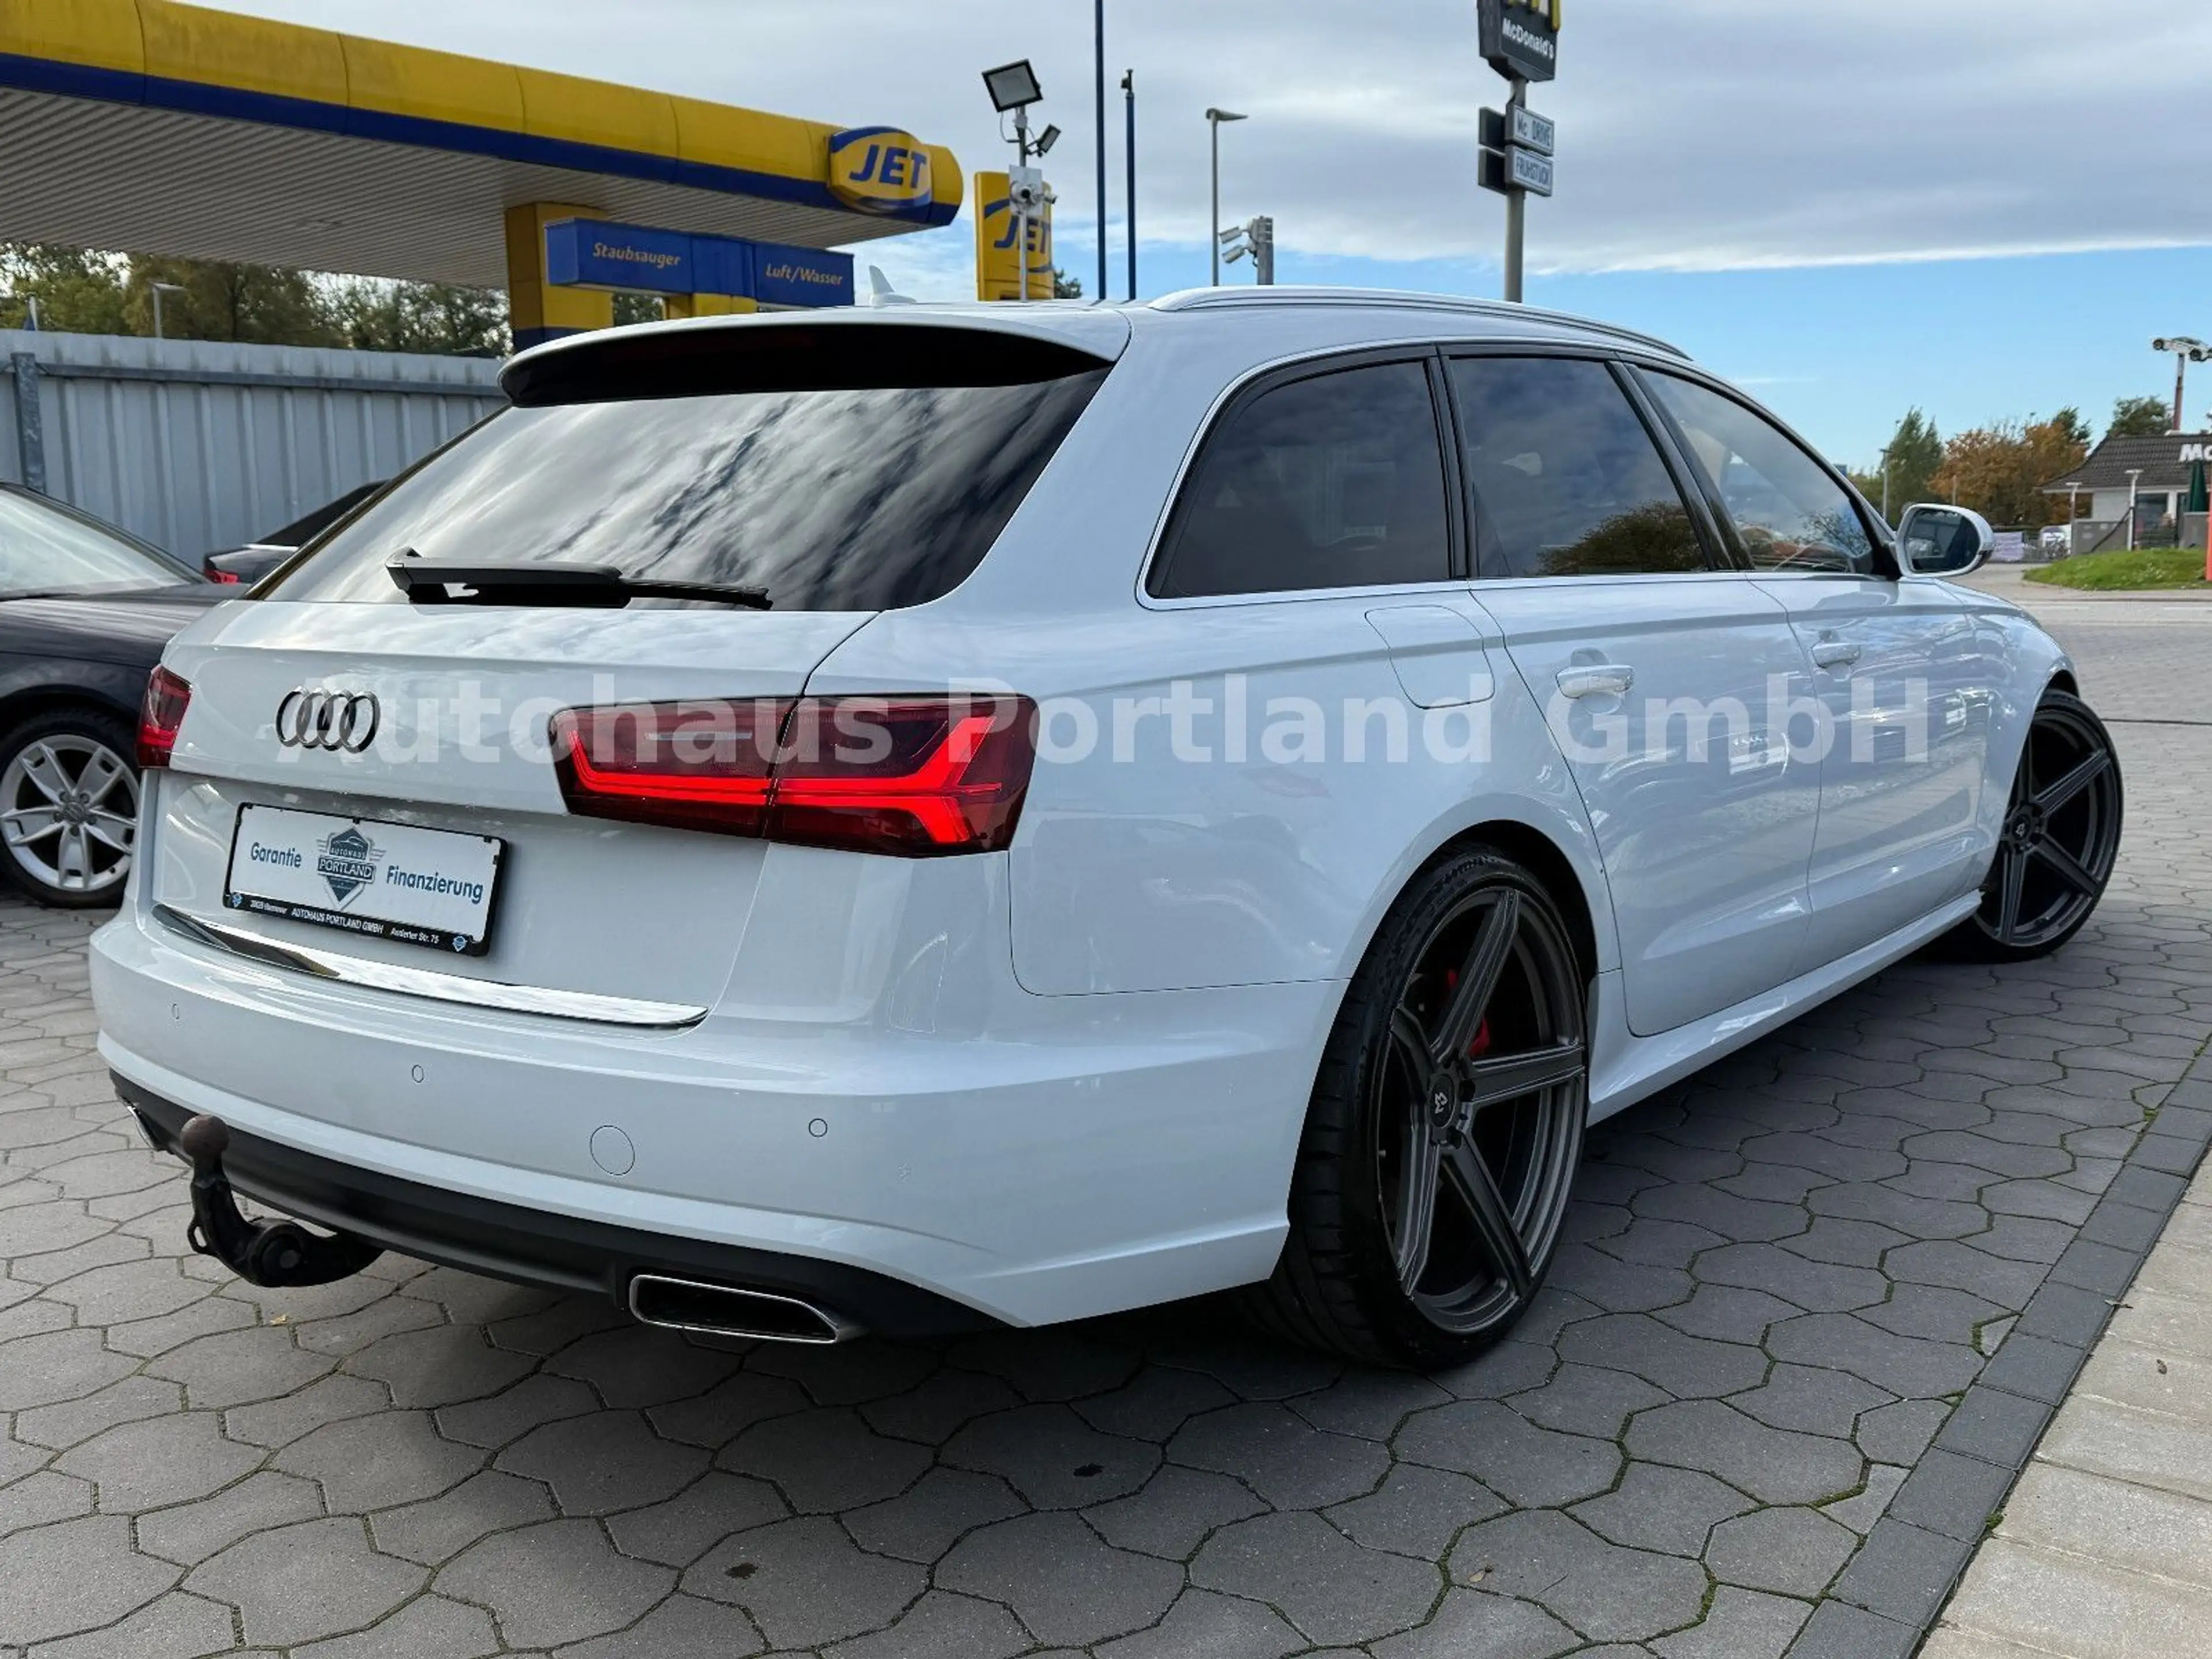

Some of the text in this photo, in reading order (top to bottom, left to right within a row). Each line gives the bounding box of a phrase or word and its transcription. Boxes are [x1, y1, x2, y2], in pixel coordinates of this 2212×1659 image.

[1502, 17, 1554, 59] McDonald's
[849, 144, 928, 188] JET
[994, 215, 1051, 254] JET
[593, 243, 681, 268] Staubsauger
[766, 263, 843, 286] Luft/Wasser
[251, 842, 302, 868] Garantie
[319, 858, 372, 878] PORTLAND
[386, 865, 484, 904] Finanzierung
[291, 907, 325, 923] AUTOHAUS
[325, 914, 362, 930] PORTLAND
